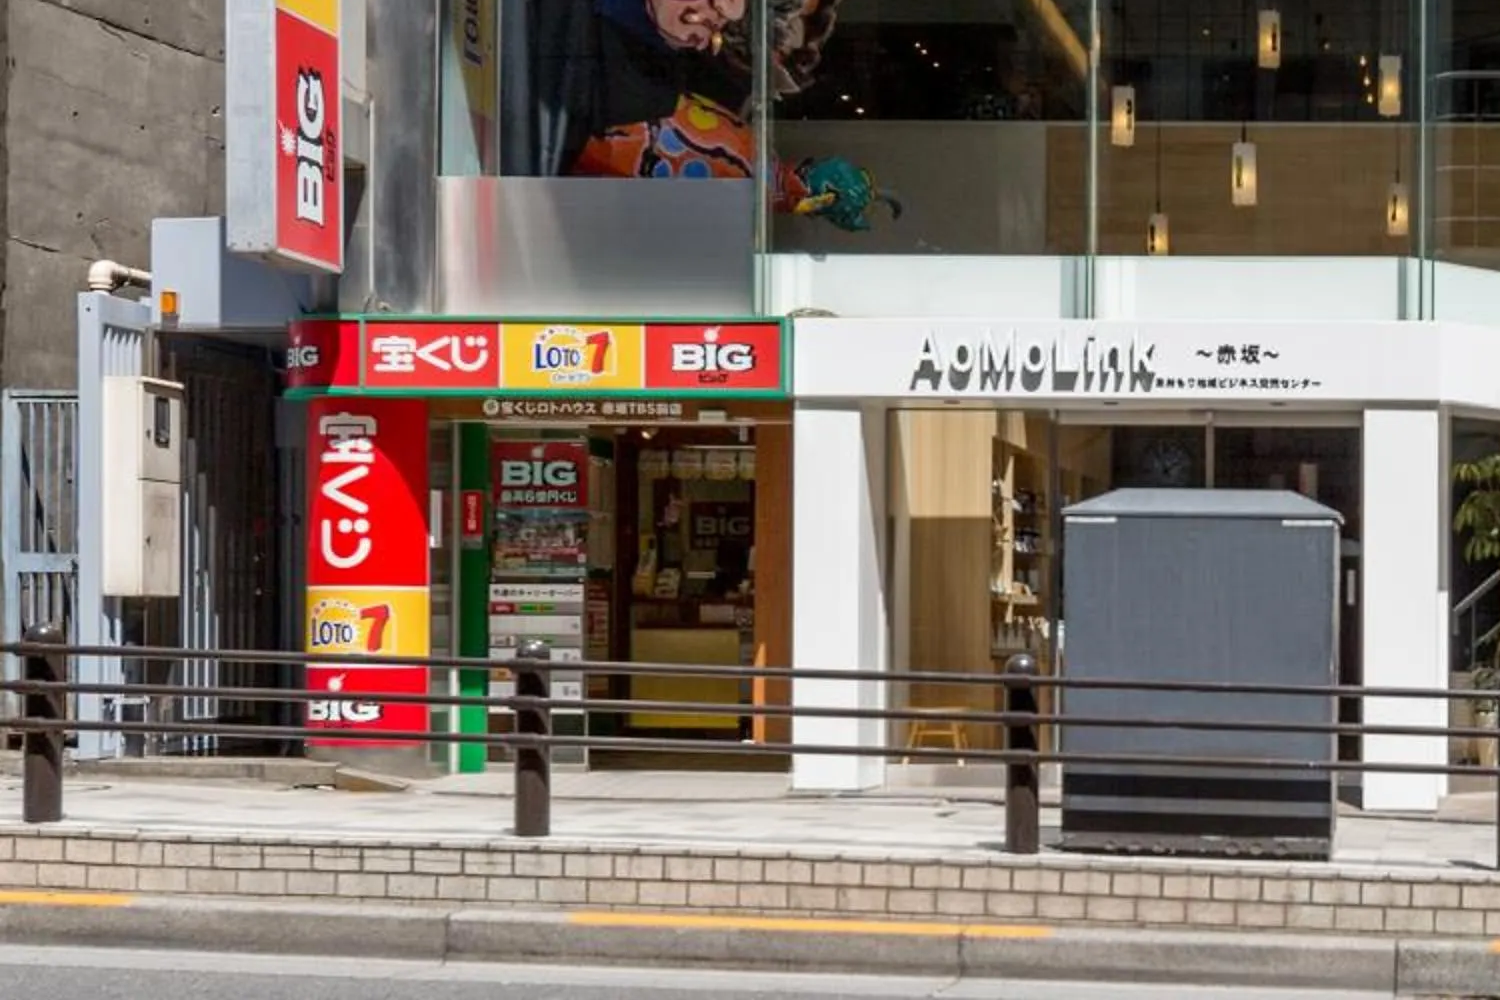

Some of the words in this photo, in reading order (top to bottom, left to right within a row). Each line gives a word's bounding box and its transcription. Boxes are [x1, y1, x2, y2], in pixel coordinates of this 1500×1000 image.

[371, 335, 489, 372] 宝くじ
[534, 342, 581, 371] LOTO
[585, 330, 611, 374] 7
[319, 412, 378, 569] 宝くじ
[311, 617, 354, 647] LOTO
[359, 603, 390, 652] 7
